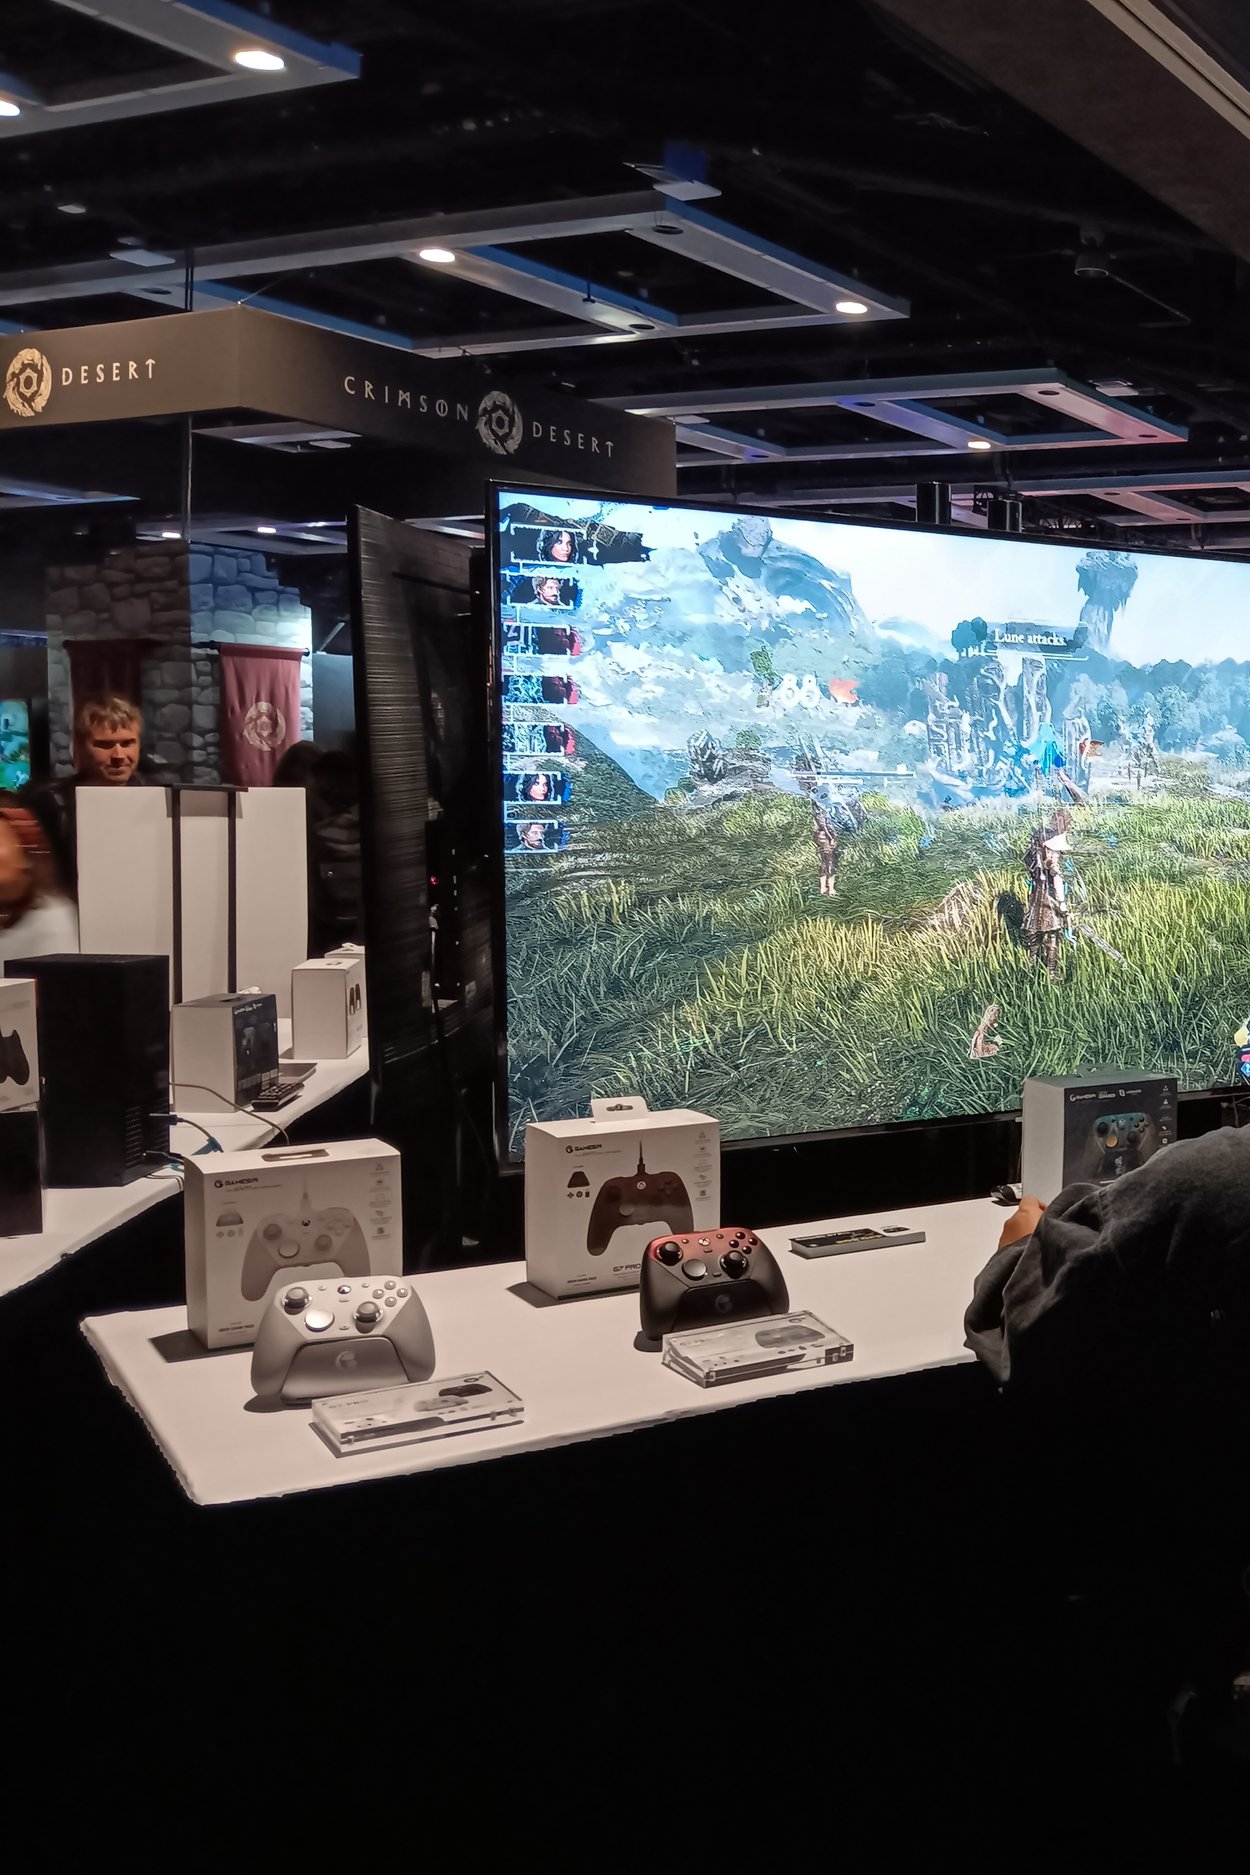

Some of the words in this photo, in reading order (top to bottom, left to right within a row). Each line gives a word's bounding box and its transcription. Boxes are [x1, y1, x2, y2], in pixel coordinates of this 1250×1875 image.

[61, 358, 157, 387] DESERT
[344, 376, 469, 422] CRIMSON
[532, 421, 615, 458] DESERT
[994, 628, 1025, 643] Lune
